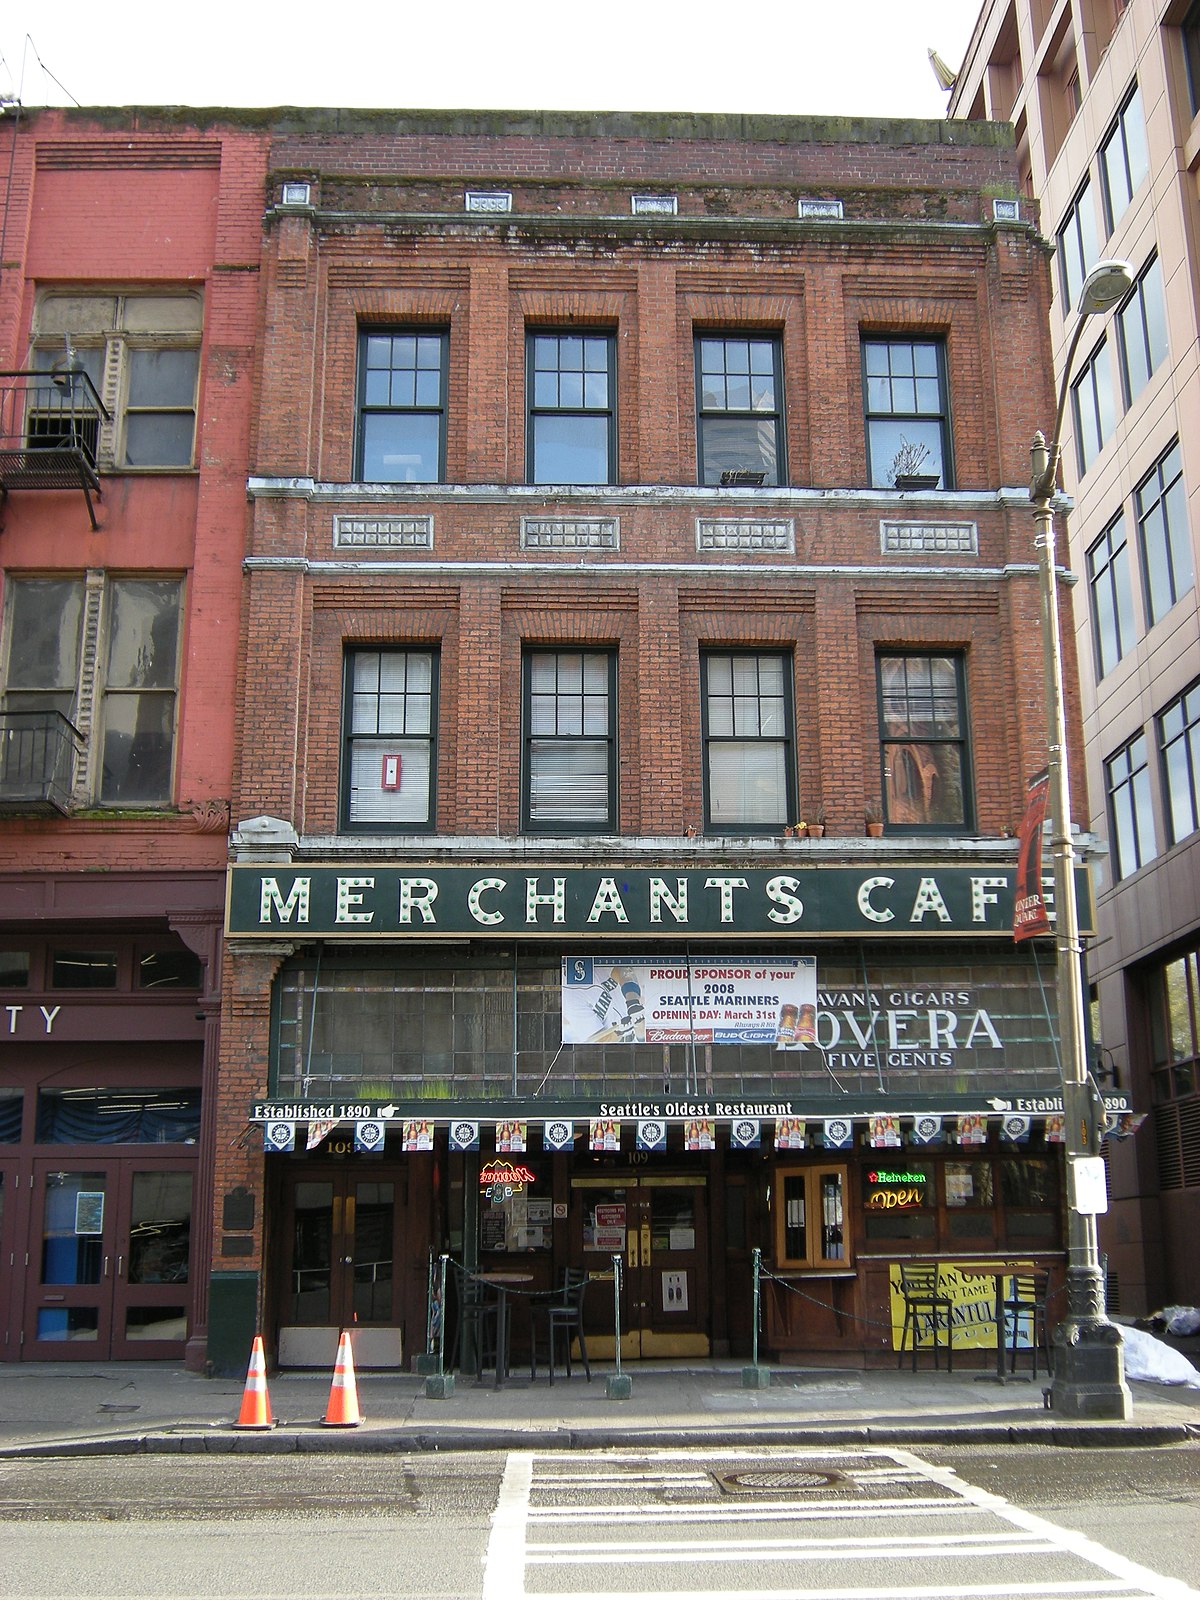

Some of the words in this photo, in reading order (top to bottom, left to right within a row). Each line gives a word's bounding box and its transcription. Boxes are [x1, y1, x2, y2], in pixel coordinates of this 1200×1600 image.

[259, 876, 804, 925] MERCHANTS
[1016, 894, 1042, 912] ONEER
[1013, 908, 1039, 927] QUARE
[649, 969, 690, 979] PROUD
[694, 969, 751, 980] SPONSOR
[754, 969, 768, 980] of
[770, 971, 796, 982] your
[704, 984, 735, 994] 2008
[659, 995, 710, 1006] SEATTLE
[713, 995, 779, 1006] MARINERS
[816, 993, 880, 1006] AVANA
[5, 1005, 61, 1033] TY
[652, 1010, 697, 1020] OPENING
[699, 1010, 722, 1020] DAY:
[724, 1010, 753, 1020] March
[755, 1010, 776, 1020] 31st
[649, 1030, 710, 1041] Budweser
[775, 1009, 1004, 1050] OVERA
[828, 1053, 876, 1067] FIVE
[254, 1104, 334, 1118] Established
[339, 1105, 371, 1118] 1890
[599, 1102, 660, 1117] Seattle's
[665, 1102, 710, 1116] Oldest
[715, 1102, 793, 1115] Restaurant
[1017, 1098, 1063, 1112] Establi
[1105, 1097, 1127, 1110] 890
[628, 1151, 648, 1164] 109
[877, 1171, 927, 1183] Heineken
[871, 1188, 924, 1208] Open
[960, 1284, 989, 1297] TAME
[916, 1301, 1010, 1343] TARANTUL
